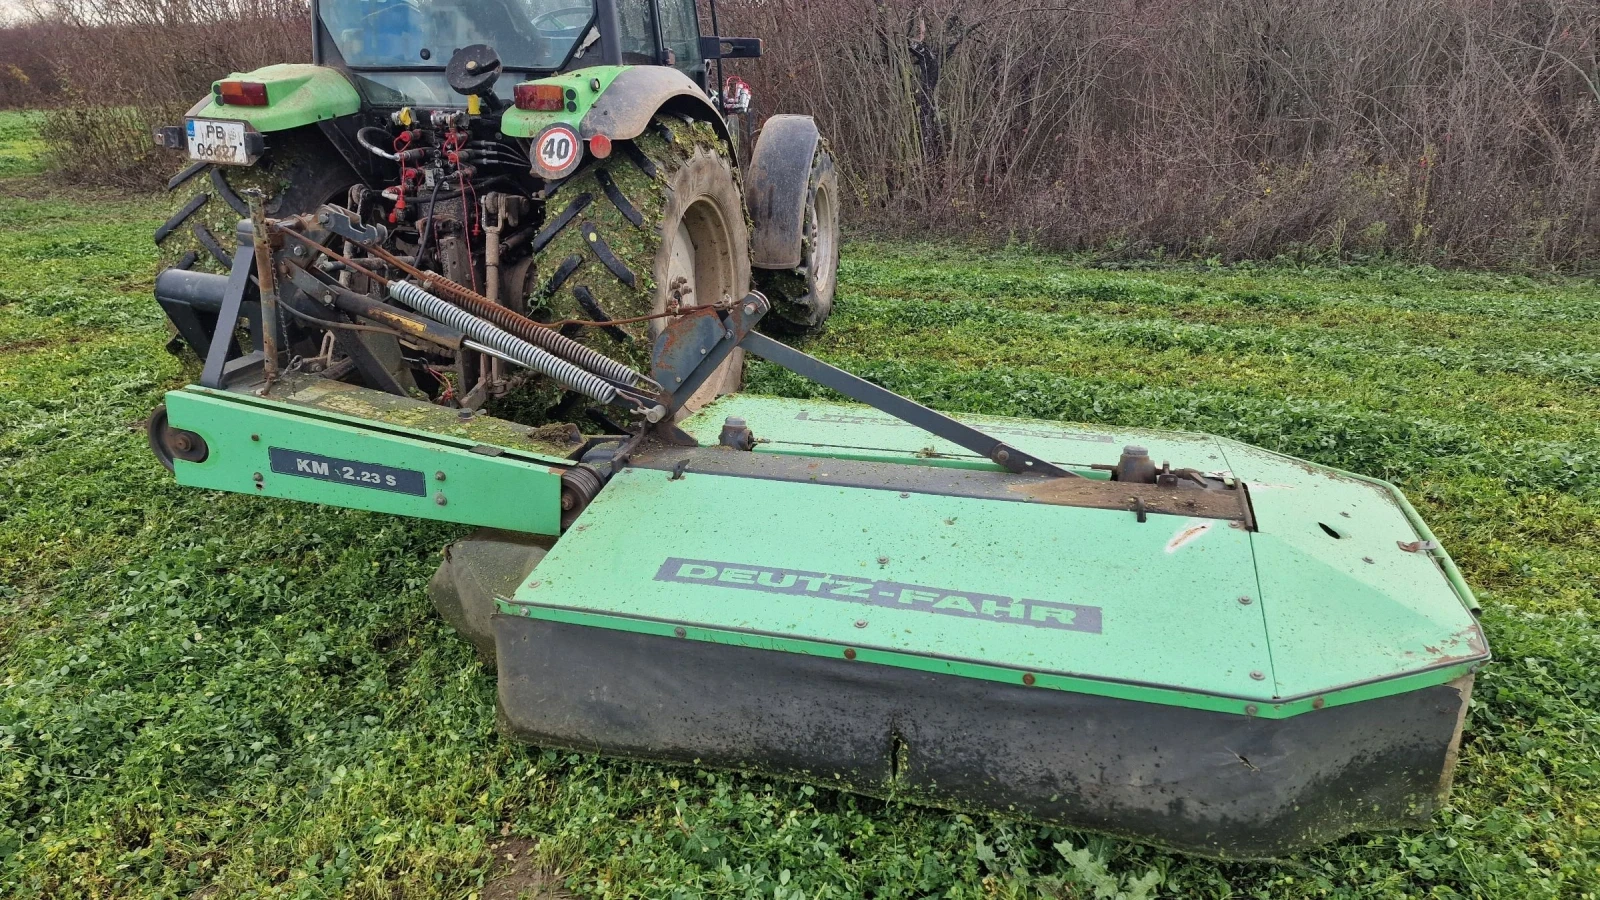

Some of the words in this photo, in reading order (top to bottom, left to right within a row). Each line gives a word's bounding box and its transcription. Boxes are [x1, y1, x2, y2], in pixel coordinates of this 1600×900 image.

[206, 125, 225, 139] PB
[542, 138, 570, 160] 40
[296, 458, 329, 476] KM
[342, 467, 381, 484] 2.23
[385, 474, 397, 486] S
[675, 563, 1077, 625] DEUTZ-FAHR
